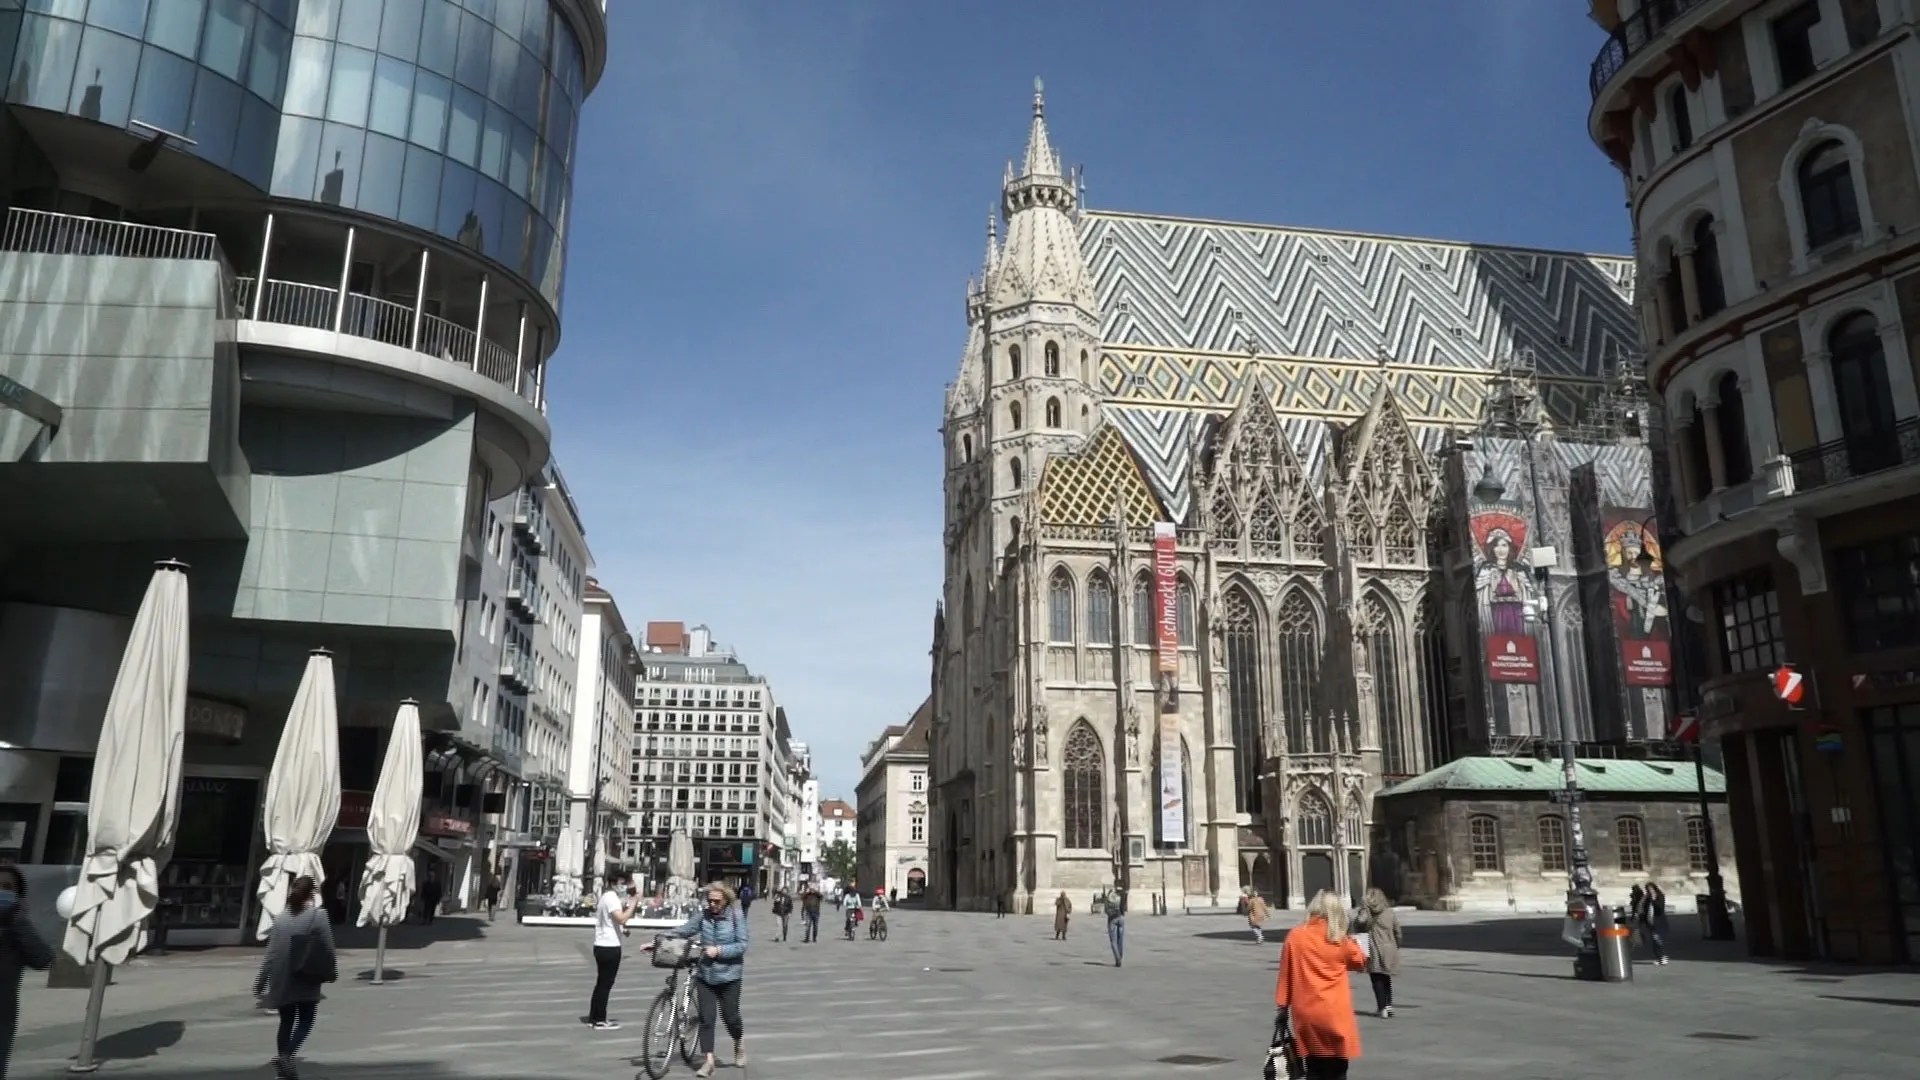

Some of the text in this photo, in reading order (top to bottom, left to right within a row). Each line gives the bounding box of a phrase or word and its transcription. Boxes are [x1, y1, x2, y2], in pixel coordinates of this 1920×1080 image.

[1157, 548, 1176, 577] GUT!
[1158, 581, 1177, 637] schmeckt
[1159, 638, 1177, 668] MUT
